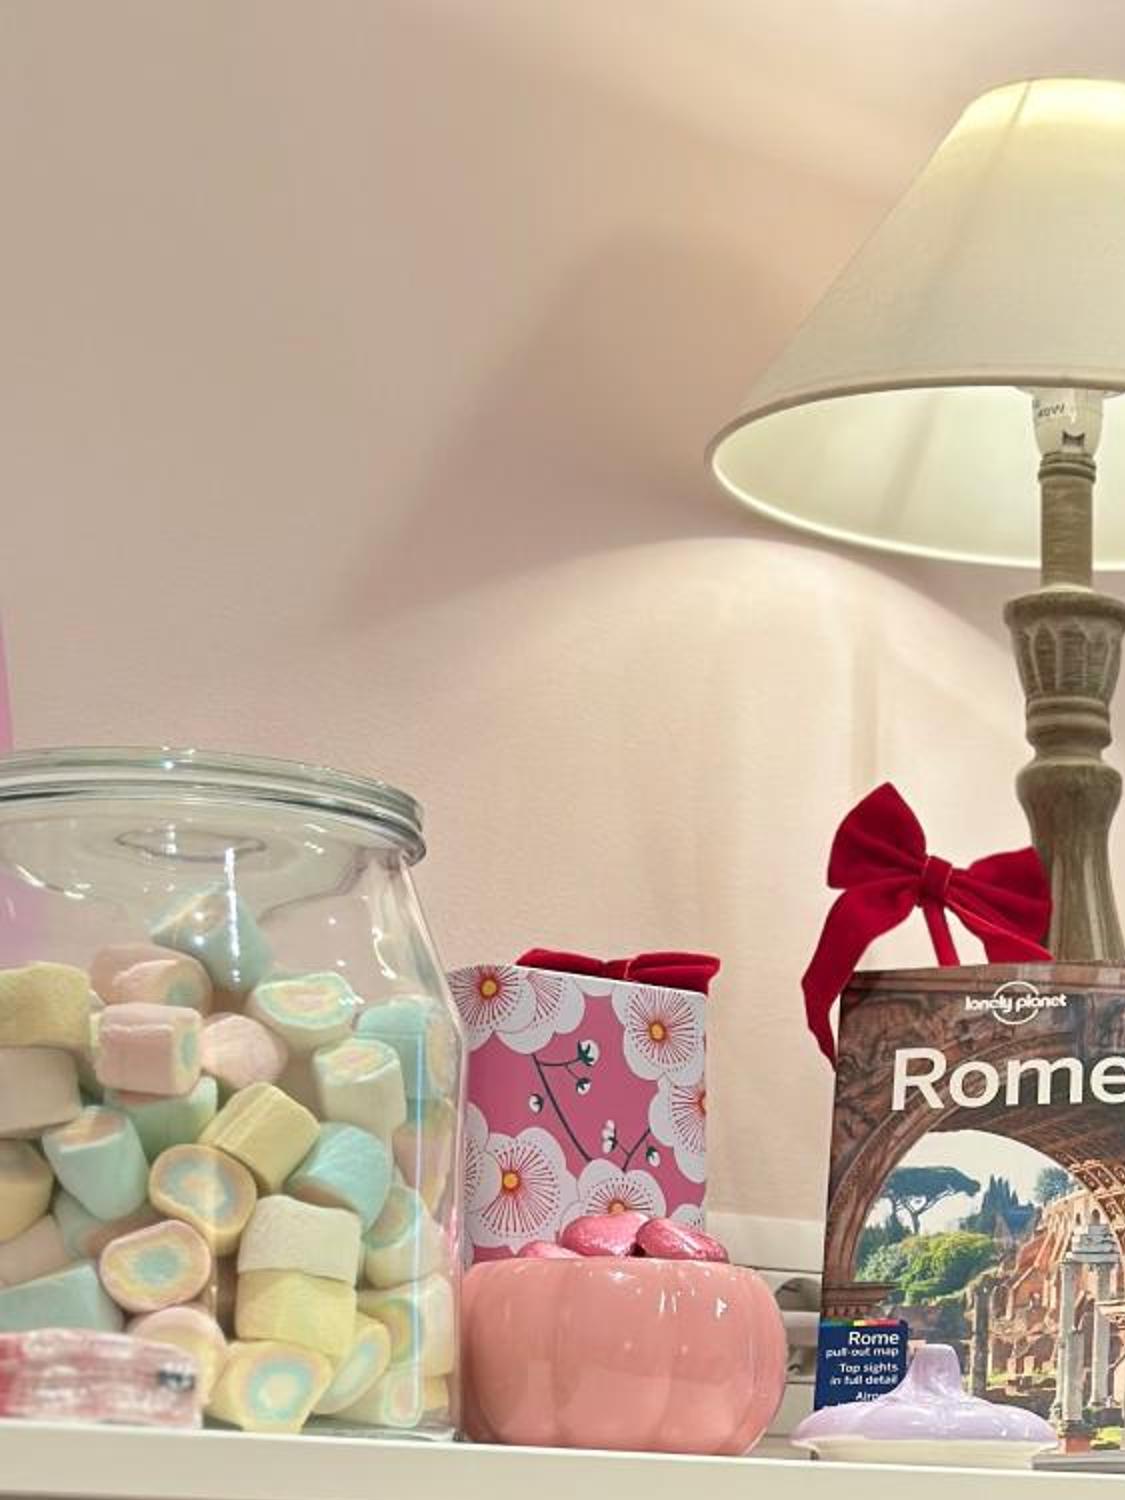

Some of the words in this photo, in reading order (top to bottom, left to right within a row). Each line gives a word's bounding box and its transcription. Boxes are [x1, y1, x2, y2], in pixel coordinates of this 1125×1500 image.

[965, 995, 1013, 1013] lonely
[1016, 993, 1067, 1012] planet
[849, 1331, 900, 1345] Rome
[825, 1347, 871, 1358] pull-out
[873, 1347, 899, 1358] map
[840, 1363, 860, 1374] Top
[863, 1362, 898, 1375] sights
[830, 1375, 841, 1385] in
[844, 1375, 862, 1385] full
[865, 1375, 898, 1385] detail
